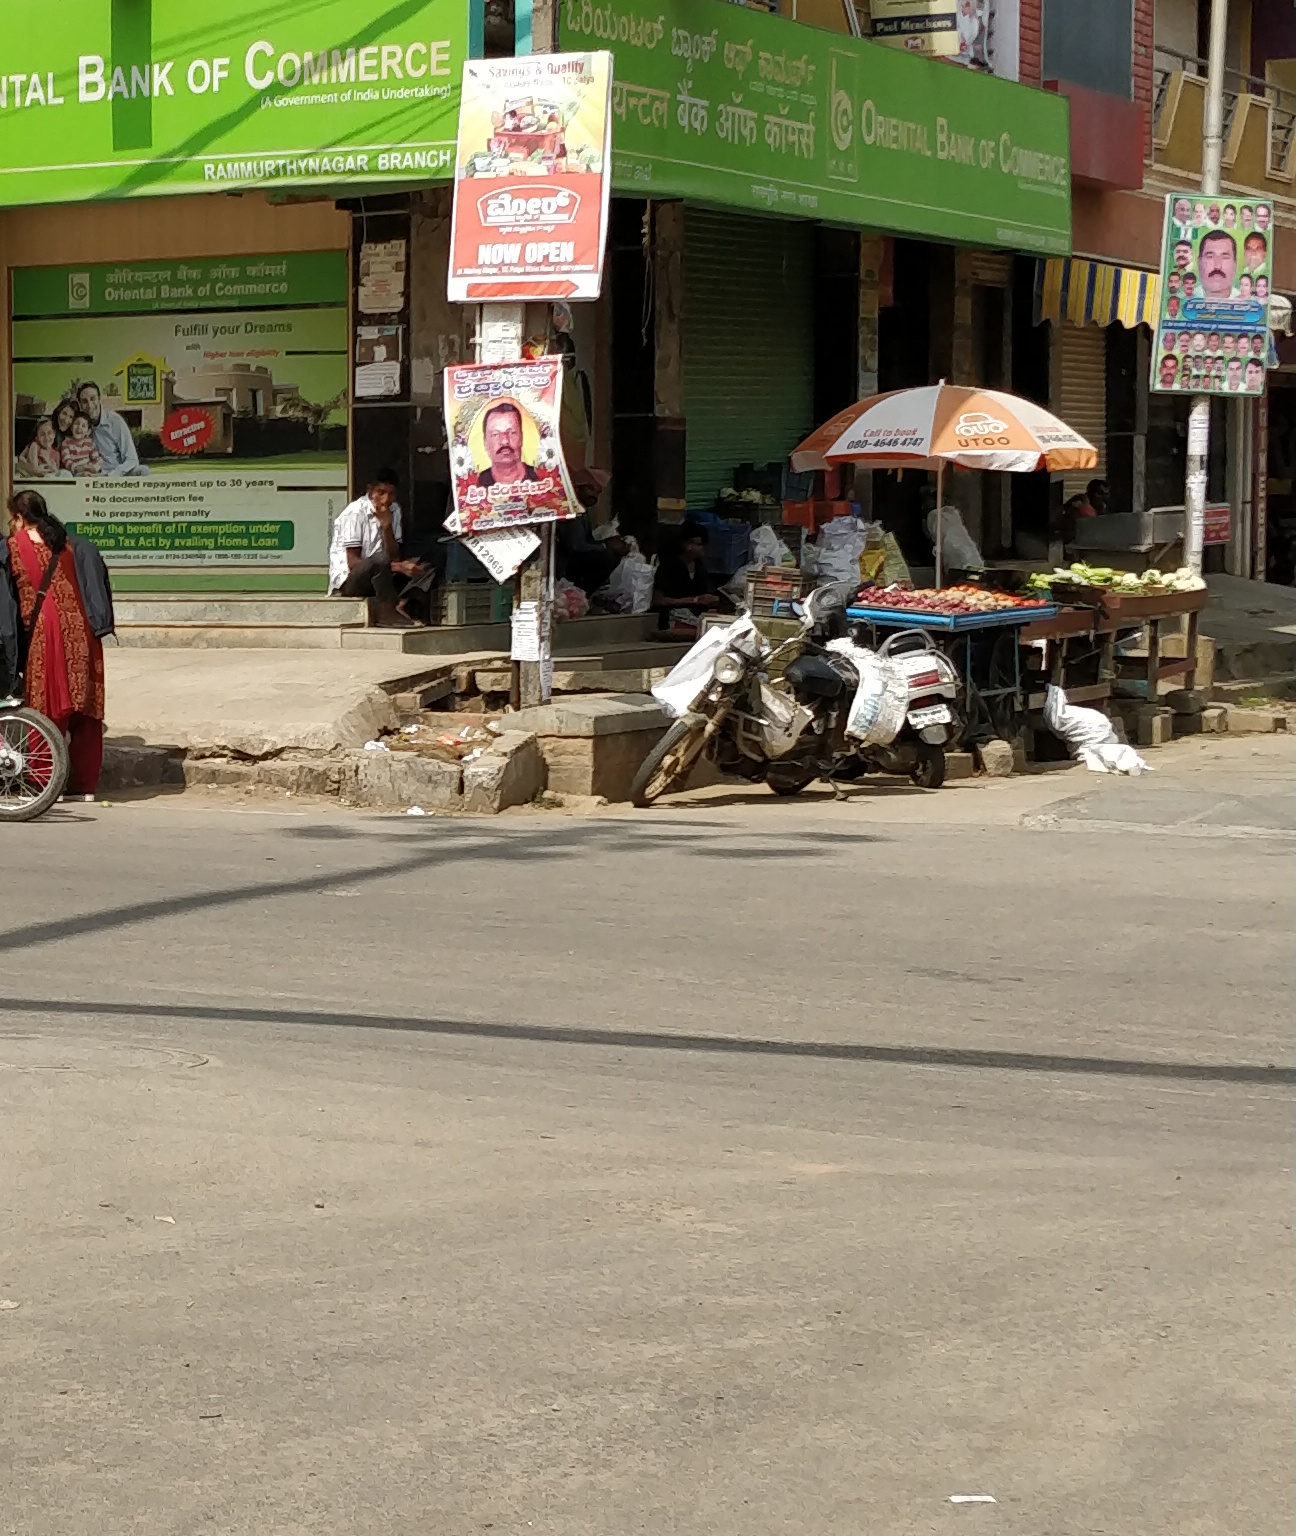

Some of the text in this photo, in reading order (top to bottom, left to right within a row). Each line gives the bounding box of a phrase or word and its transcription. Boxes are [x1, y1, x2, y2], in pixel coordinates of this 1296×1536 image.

[78, 54, 174, 103] BANK
[187, 57, 231, 94] OF
[245, 39, 452, 90] COMMERCE
[548, 60, 585, 74] Quality
[261, 83, 452, 110] (A Government of India Undertaking)
[205, 149, 452, 180] RAMMURTHYNAGAR BRANCH
[478, 241, 575, 265] NOW OPEN
[104, 281, 288, 301] Oriental Bank of Commerce
[174, 322, 293, 339] Fulfill your Dreams
[863, 427, 918, 438] Call to book
[957, 436, 1011, 448] UTOO
[92, 479, 275, 492] Extended repayment up to 30 years
[92, 494, 205, 504] No documentation fee
[92, 509, 211, 520] No prepayment penalty
[76, 523, 281, 536] Enjoy the benefit of IT exemption under
[118, 536, 136, 547] Tax
[137, 536, 155, 547] Act
[158, 536, 171, 549] by
[174, 536, 215, 549] availing
[217, 536, 248, 547] Home
[251, 536, 279, 547] Loan
